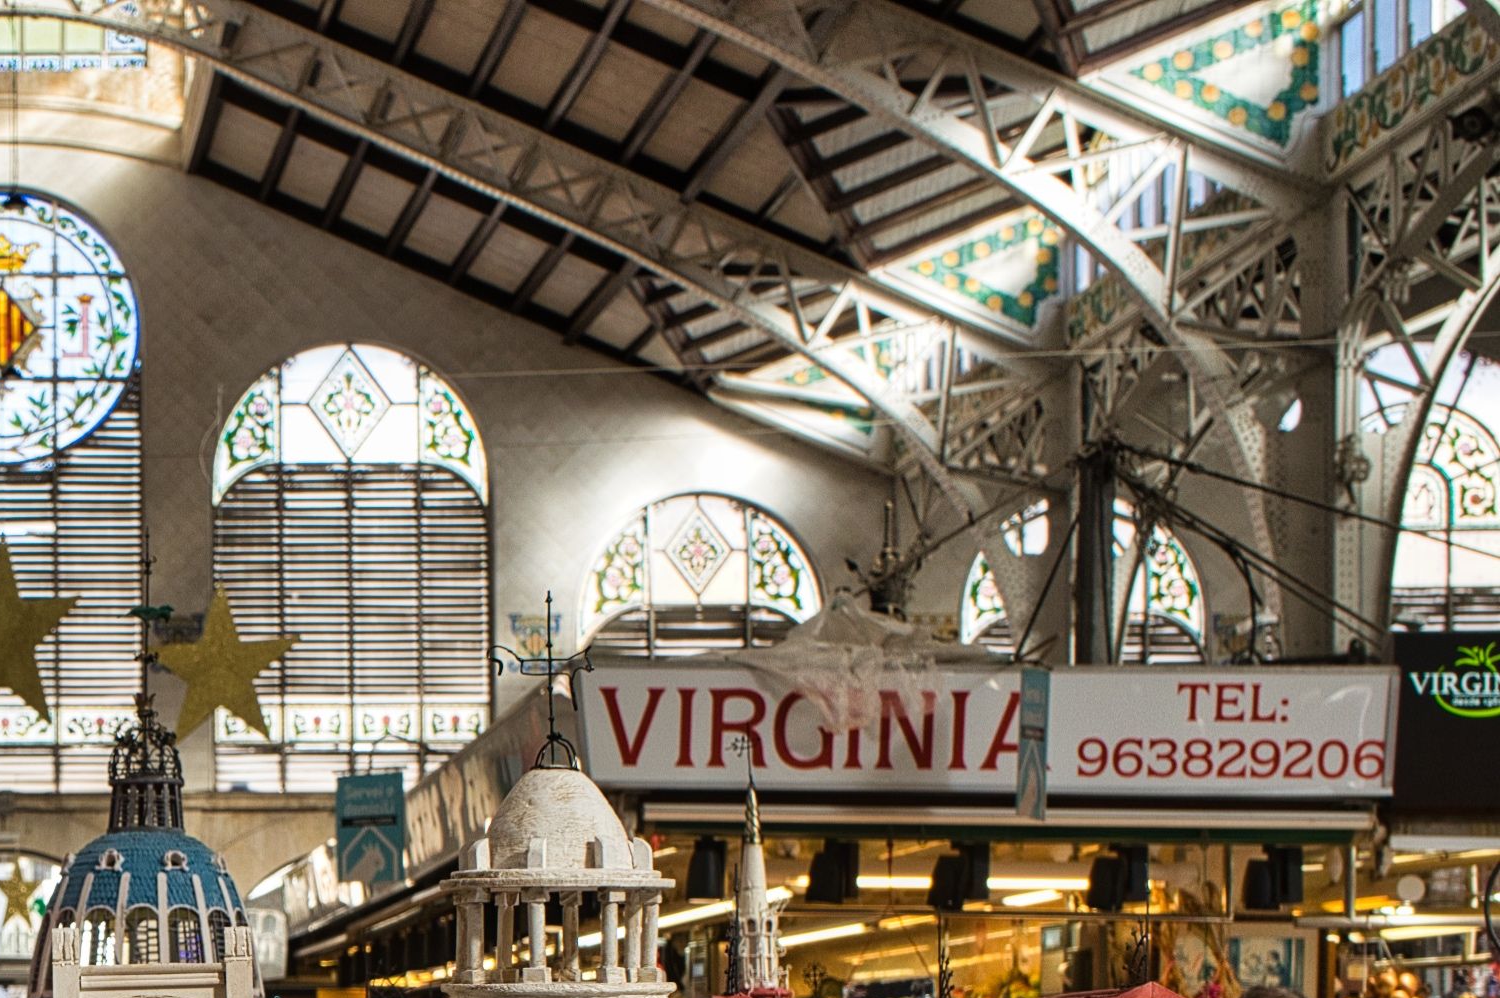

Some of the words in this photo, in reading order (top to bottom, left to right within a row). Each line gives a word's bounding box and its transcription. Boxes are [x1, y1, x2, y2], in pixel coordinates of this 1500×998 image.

[1177, 682, 1289, 723] TEL:
[598, 686, 1051, 771] VIRGINIA
[1076, 737, 1385, 780] 963829206
